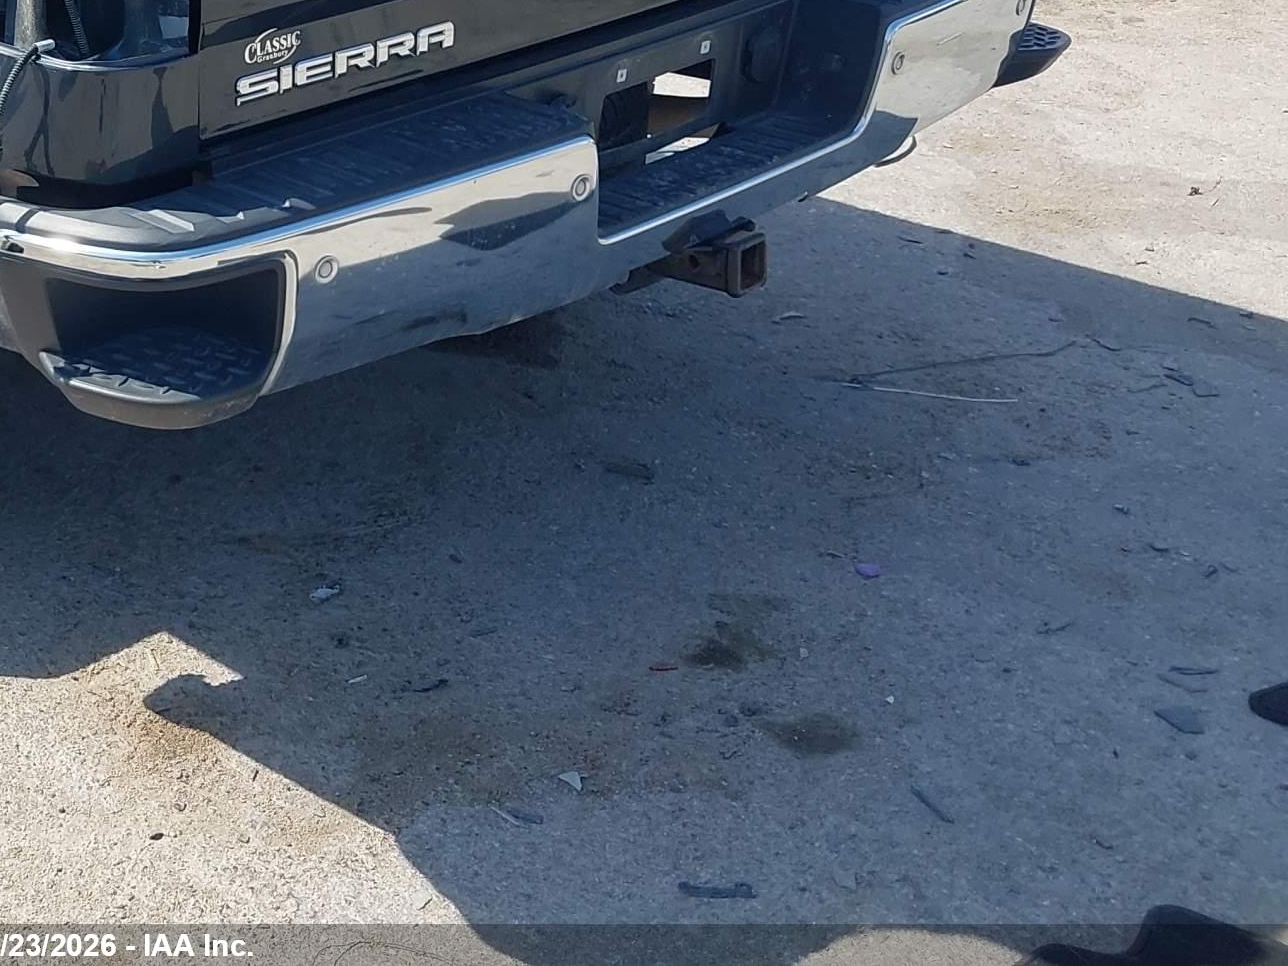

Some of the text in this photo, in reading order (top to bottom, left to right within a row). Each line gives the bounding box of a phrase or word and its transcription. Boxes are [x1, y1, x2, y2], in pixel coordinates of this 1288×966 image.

[235, 21, 455, 107] SIERRA
[244, 30, 301, 64] CLASSIC
[257, 50, 289, 63] Granbury
